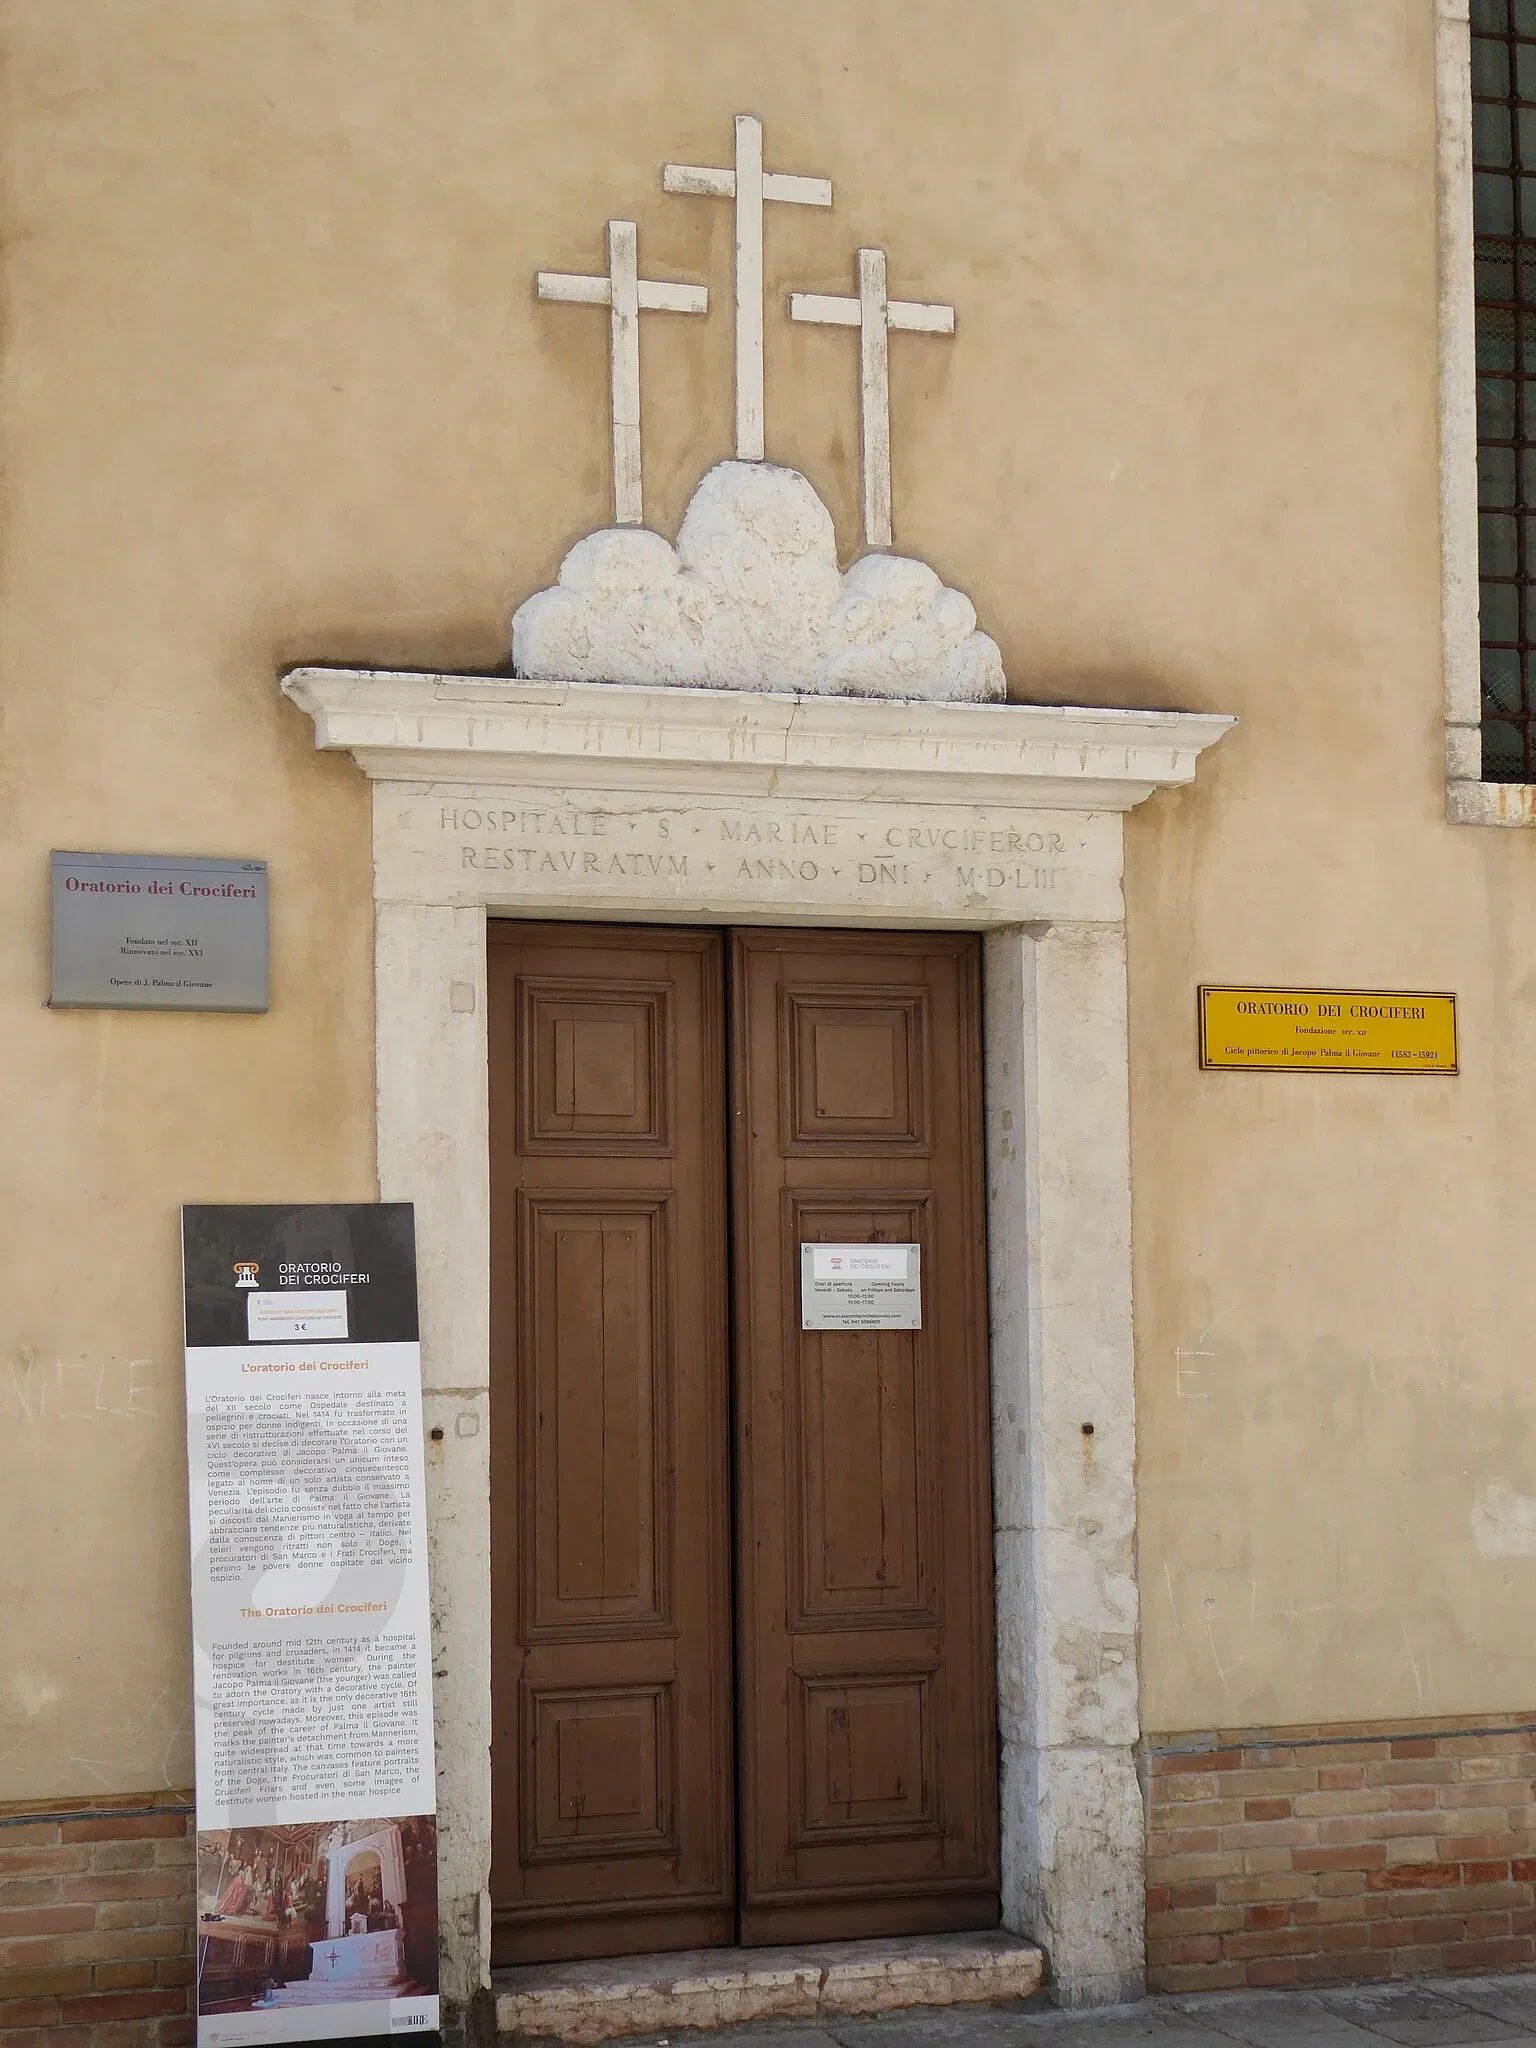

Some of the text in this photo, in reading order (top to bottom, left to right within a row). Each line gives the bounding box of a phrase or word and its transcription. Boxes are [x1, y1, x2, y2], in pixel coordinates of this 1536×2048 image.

[440, 808, 606, 836] HOSPITALE
[659, 818, 670, 839] S
[721, 820, 838, 845] MARIAE
[461, 846, 688, 876] RESTAVRATVM
[737, 858, 819, 881] ANNO
[65, 877, 256, 898] Oratorio dei Crociferi
[126, 937, 155, 946] Fondato
[185, 938, 198, 946] XII
[120, 948, 158, 956] Rinnovato
[160, 948, 171, 956] nel
[188, 949, 204, 957] XVI
[110, 978, 133, 988] Opere
[134, 978, 142, 986] di
[152, 979, 174, 987] Palma
[183, 980, 212, 988] Giovane
[1237, 1001, 1425, 1020] ORATORIO DEI CROCIFERI
[1295, 1026, 1337, 1035] Fondazione
[1225, 1046, 1244, 1054] Ciclo
[1247, 1046, 1279, 1058] pittorico
[1281, 1048, 1289, 1056] di
[1291, 1048, 1316, 1058] Jacopo
[1320, 1048, 1342, 1057] Palma
[1345, 1049, 1350, 1057] il
[1352, 1050, 1380, 1058] Giovane
[279, 1262, 342, 1274] ORATORIO
[280, 1273, 370, 1285] DEI CROCIFERI
[242, 1360, 369, 1373] L'oratorio dei Crociferi
[266, 1392, 301, 1400] Crociferi
[309, 1400, 347, 1410] Ospedale
[355, 1399, 393, 1407] destinato
[239, 1468, 284, 1478] complesso
[292, 1466, 336, 1474] decorativo
[344, 1464, 409, 1475] cinquecentesco
[208, 1497, 240, 1507] periodo
[309, 1494, 334, 1502] Palma
[210, 1563, 241, 1573] persino
[262, 1563, 290, 1571] povere
[297, 1560, 323, 1568] donne
[330, 1558, 363, 1568] ospitate
[210, 1574, 242, 1582] ospizio.
[240, 1602, 388, 1618] The Oratorio dei Crociferi
[212, 1641, 248, 1650] Founded
[252, 1640, 281, 1648] around
[285, 1639, 301, 1647] mid
[305, 1638, 322, 1646] 12th
[326, 1636, 357, 1647] century
[382, 1634, 415, 1644] hospital
[212, 1652, 224, 1660] for
[228, 1650, 261, 1661] pilgrims
[265, 1649, 281, 1657] and
[285, 1647, 328, 1658] crusaders,
[344, 1646, 360, 1654] 1414
[374, 1643, 407, 1652] became
[212, 1661, 244, 1671] hospice
[276, 1657, 314, 1666] destitute
[366, 1654, 393, 1664] During
[212, 1670, 257, 1679] renovation
[262, 1668, 287, 1677] works
[306, 1666, 324, 1675] 16th
[329, 1665, 362, 1675] century,
[368, 1664, 381, 1672] the
[387, 1662, 416, 1672] painter
[214, 1786, 250, 1796] Cruciferi
[259, 1784, 282, 1793] Friars
[291, 1783, 306, 1791] and
[374, 1778, 403, 1788] images
